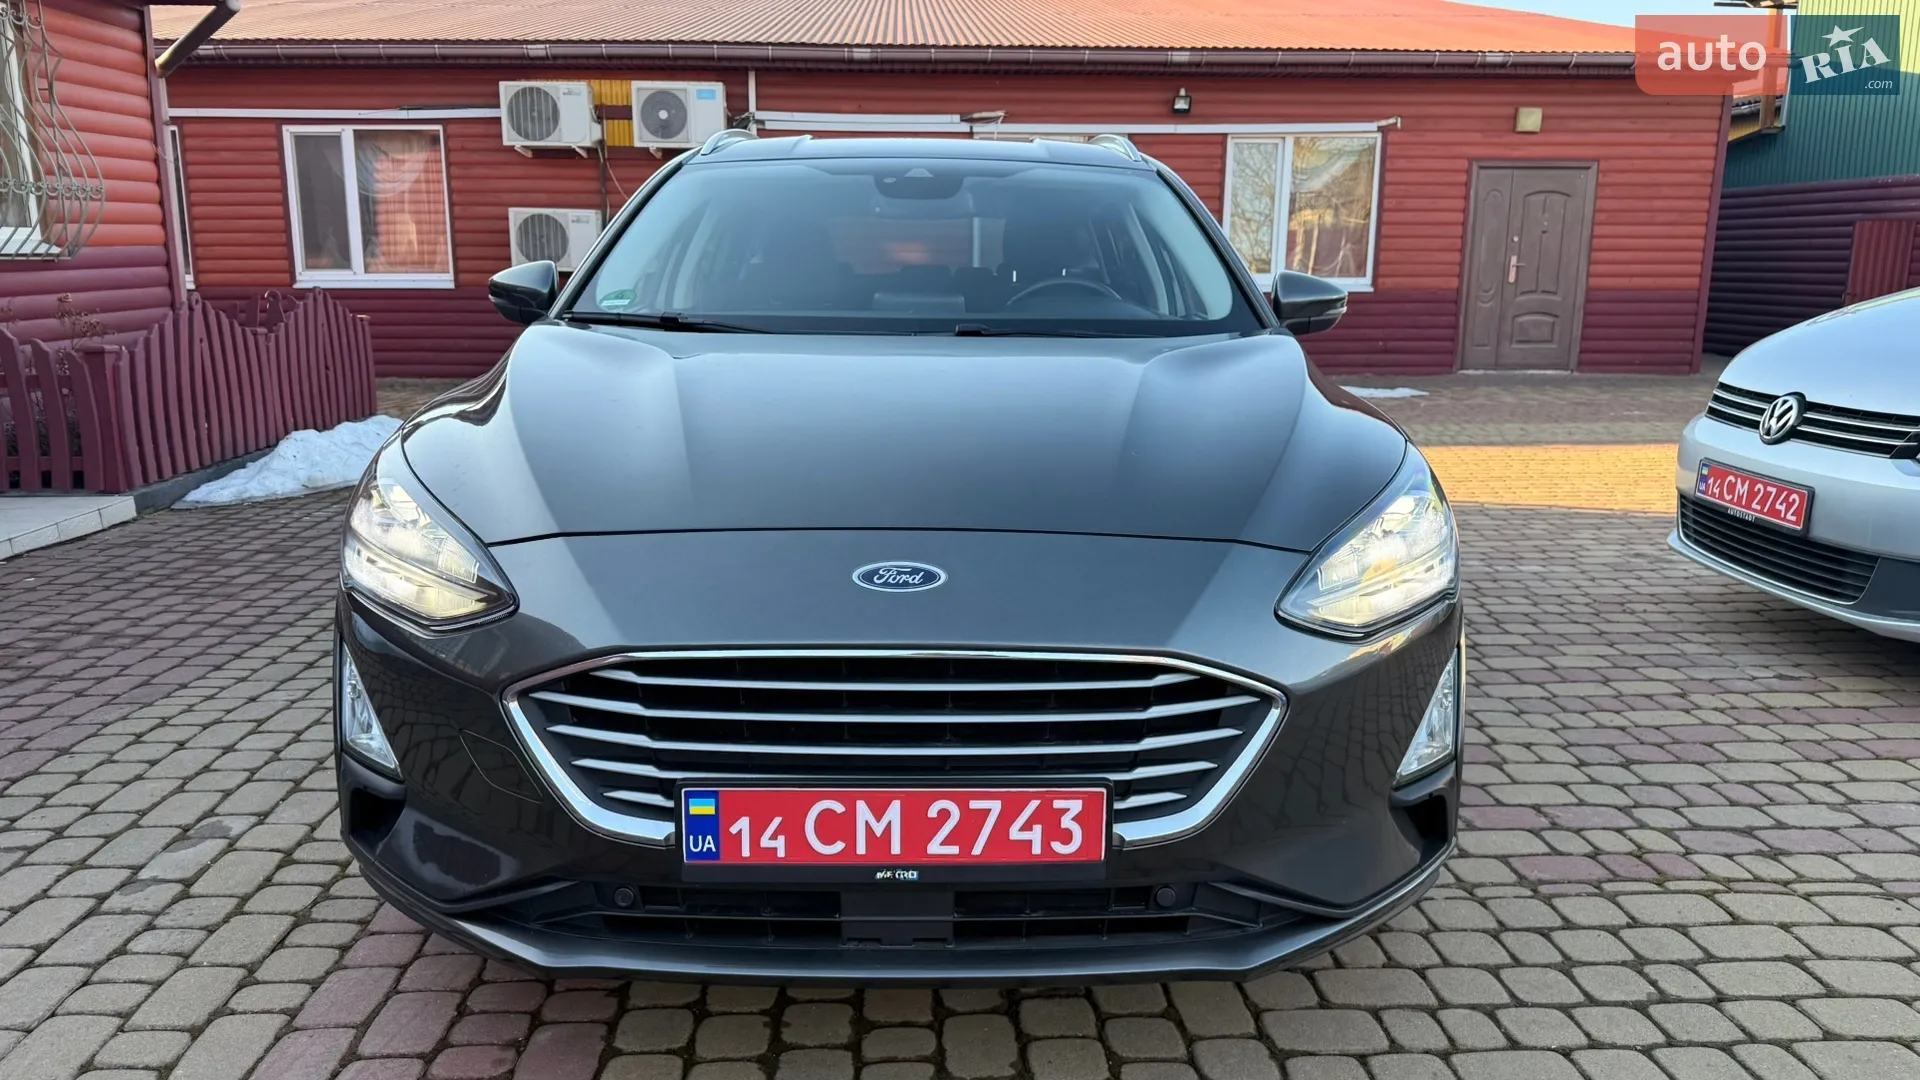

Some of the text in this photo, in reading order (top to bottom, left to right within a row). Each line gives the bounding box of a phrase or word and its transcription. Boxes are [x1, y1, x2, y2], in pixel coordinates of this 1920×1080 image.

[1707, 476, 1721, 498] 14
[1723, 475, 1750, 506] CM
[1751, 483, 1800, 522] 2742
[873, 567, 925, 584] Ford
[688, 799, 1084, 858] UA 14 CM 2743
